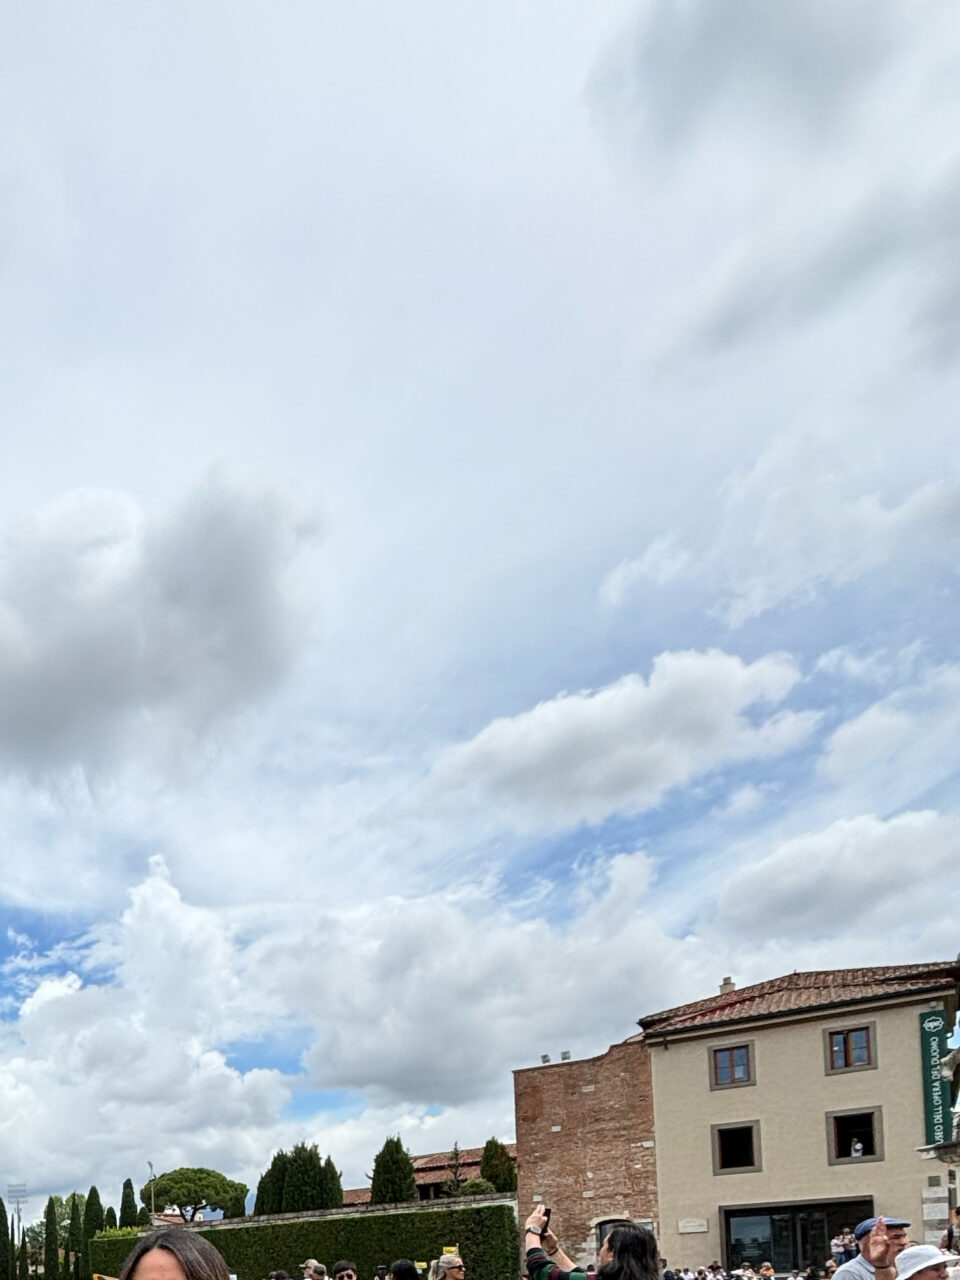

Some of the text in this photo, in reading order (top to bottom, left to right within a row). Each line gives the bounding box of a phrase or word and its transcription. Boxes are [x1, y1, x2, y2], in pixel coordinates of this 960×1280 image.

[930, 1037, 940, 1064] DUOMO
[931, 1065, 941, 1080] DEL
[935, 1124, 944, 1144] USEO
